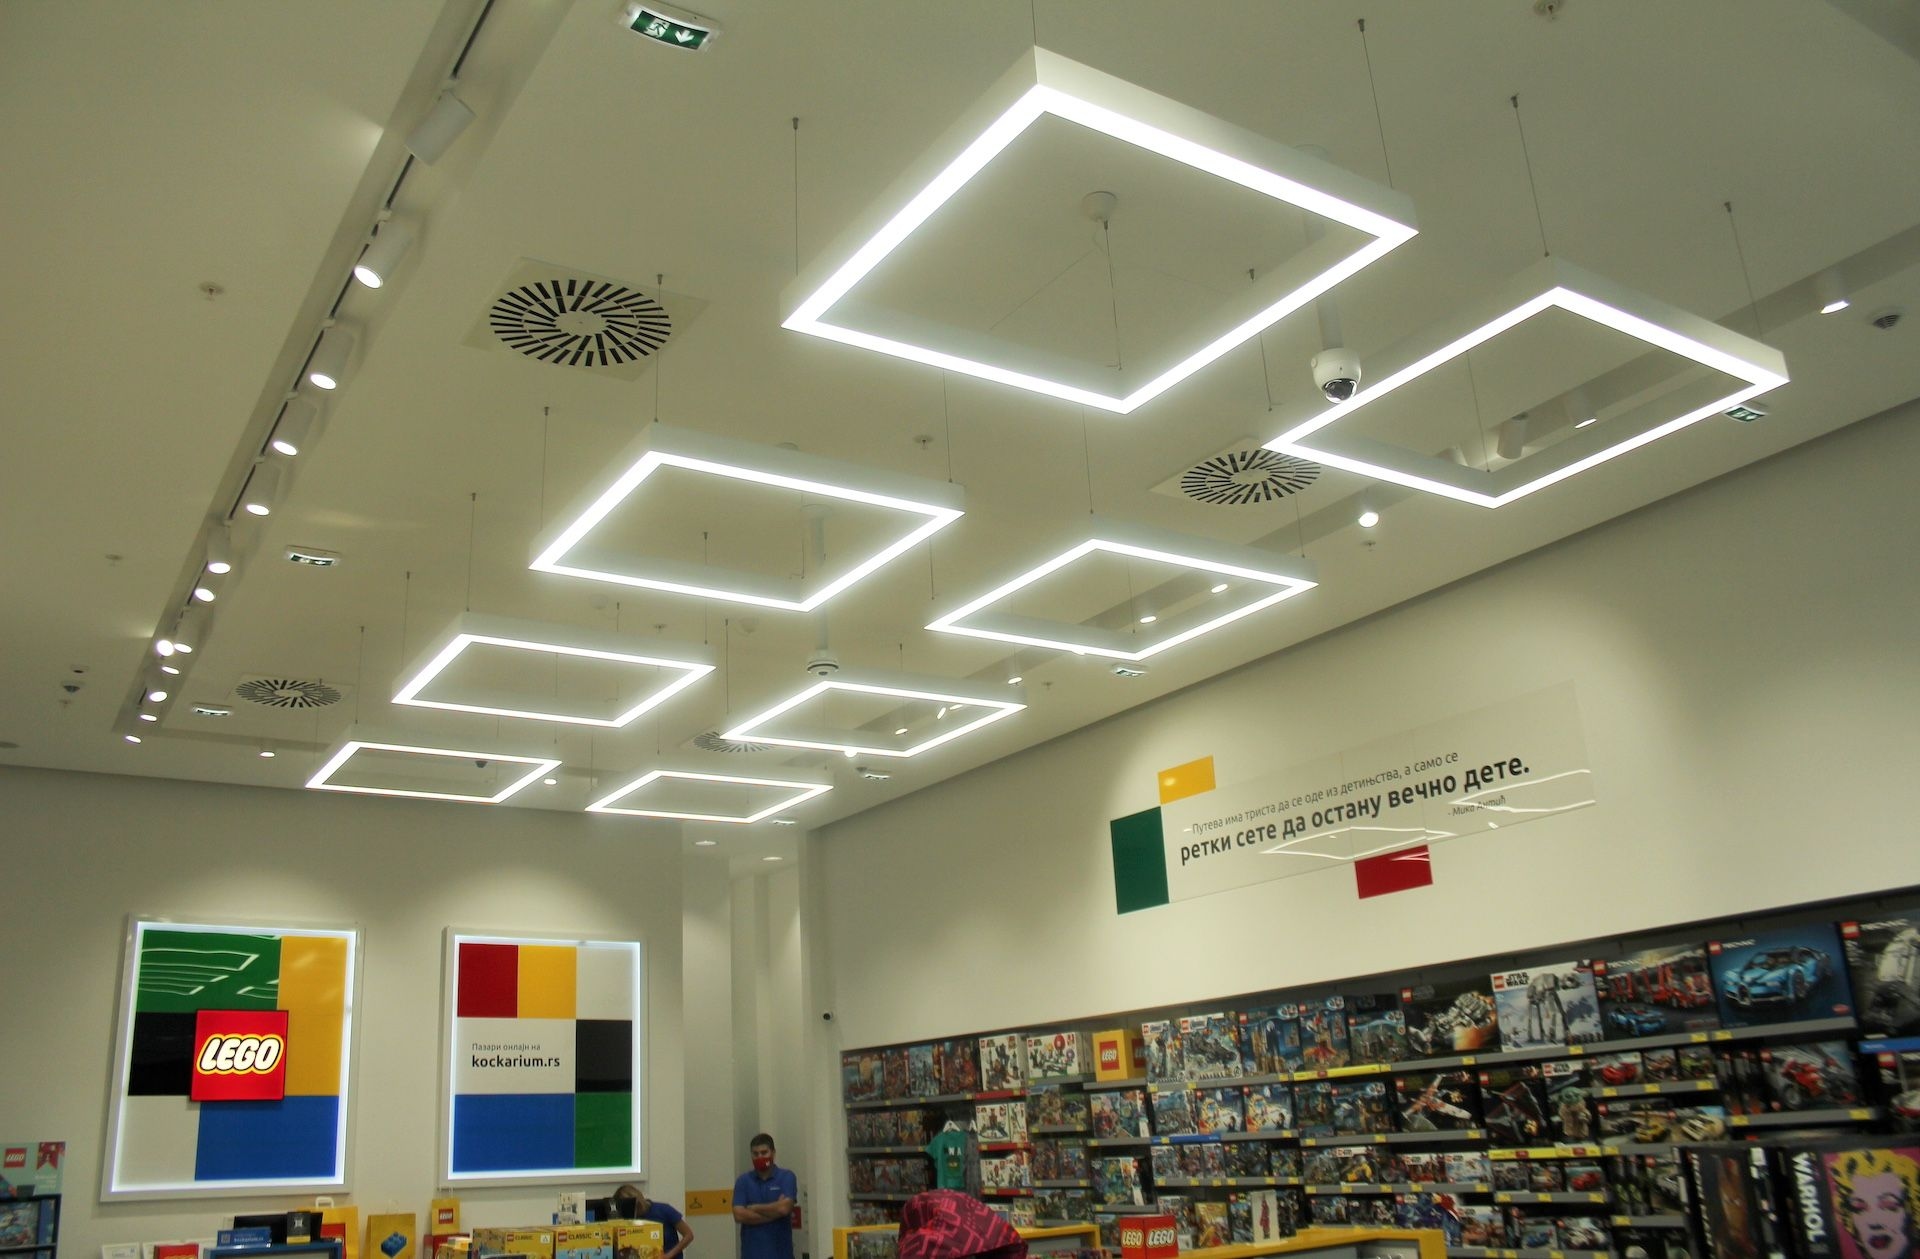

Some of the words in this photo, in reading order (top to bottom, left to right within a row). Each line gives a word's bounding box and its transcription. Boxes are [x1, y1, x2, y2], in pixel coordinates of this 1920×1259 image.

[1192, 818, 1223, 835] Путева
[1225, 813, 1243, 825] има
[1245, 804, 1276, 822] триста
[1278, 800, 1290, 813] да
[1292, 796, 1303, 808] се
[1305, 791, 1323, 804] оде
[1326, 787, 1338, 799] из
[1341, 768, 1402, 794] детињства,
[1404, 766, 1411, 776] а
[1414, 755, 1443, 773] само
[1445, 752, 1459, 764] се
[1180, 835, 1231, 866] ретки
[1236, 823, 1277, 847] сете
[1282, 815, 1306, 840] да
[1312, 795, 1381, 828] остану
[1388, 775, 1456, 808] вечно
[1464, 757, 1530, 793] дете.
[1453, 805, 1475, 817] Мика
[198, 1035, 283, 1074] LEGO
[472, 1043, 501, 1052] Пазари
[503, 1043, 530, 1052] онлајн
[472, 1054, 560, 1068] kockarium.rs
[6, 1152, 25, 1162] LEGO
[1792, 1152, 1826, 1242] WARHOL
[568, 1231, 592, 1240] CLASSIC
[1122, 1229, 1144, 1248] LEGO
[1147, 1228, 1175, 1248] LEGO
